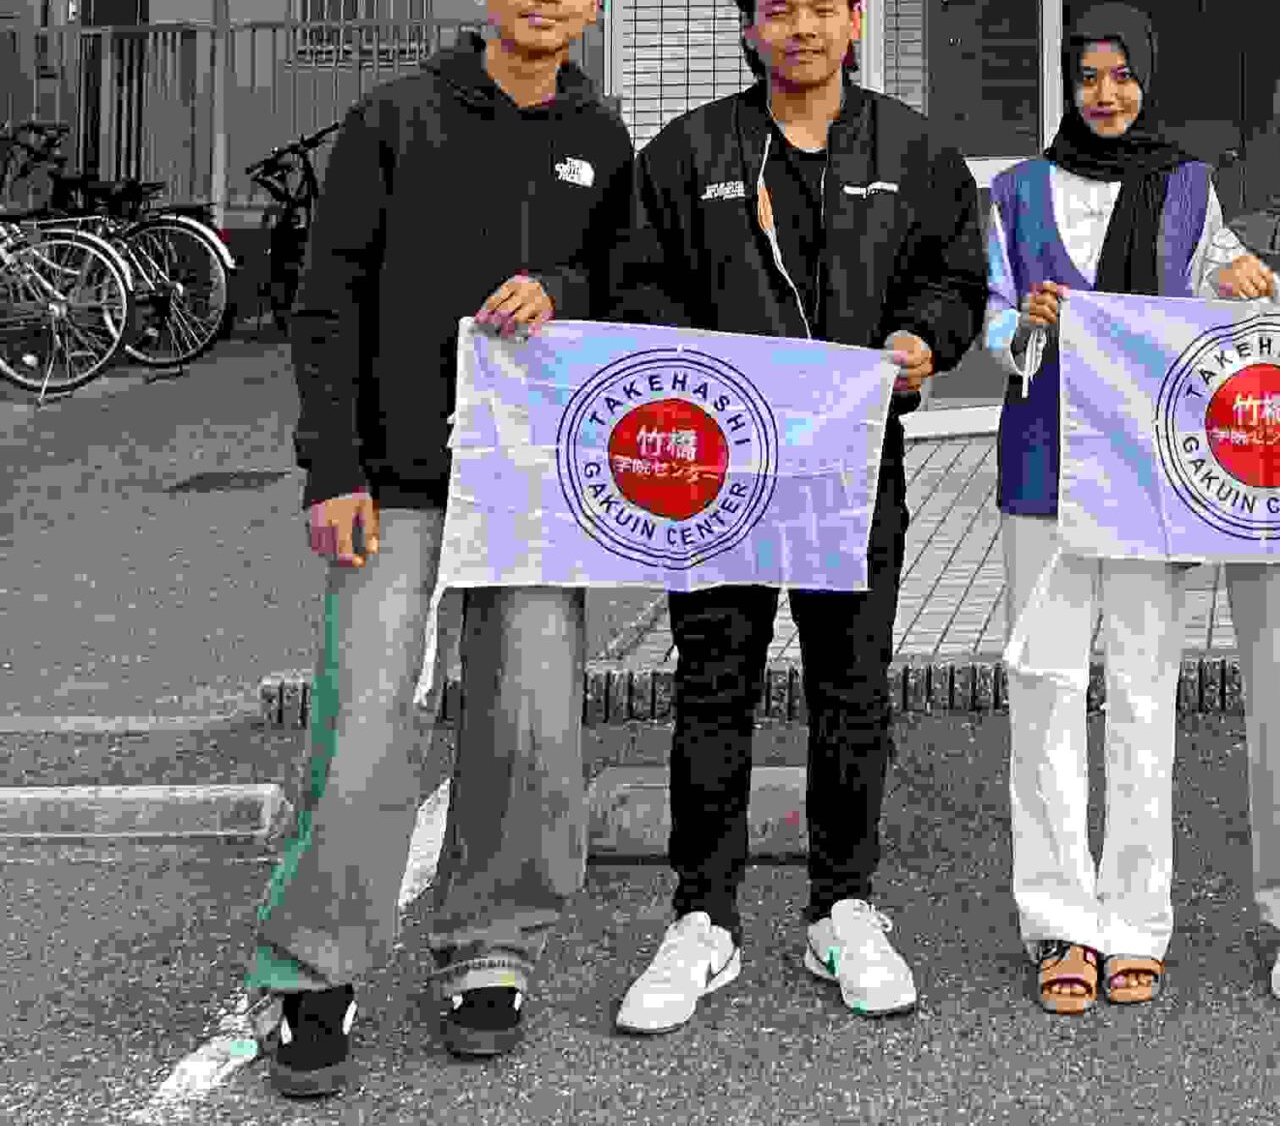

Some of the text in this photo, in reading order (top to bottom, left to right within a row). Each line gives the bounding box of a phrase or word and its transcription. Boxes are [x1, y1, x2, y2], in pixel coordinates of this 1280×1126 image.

[588, 373, 752, 446] TAKEHASHI
[583, 461, 749, 546] GAKUIN CENTER
[1182, 435, 1257, 514] GAKUIN
